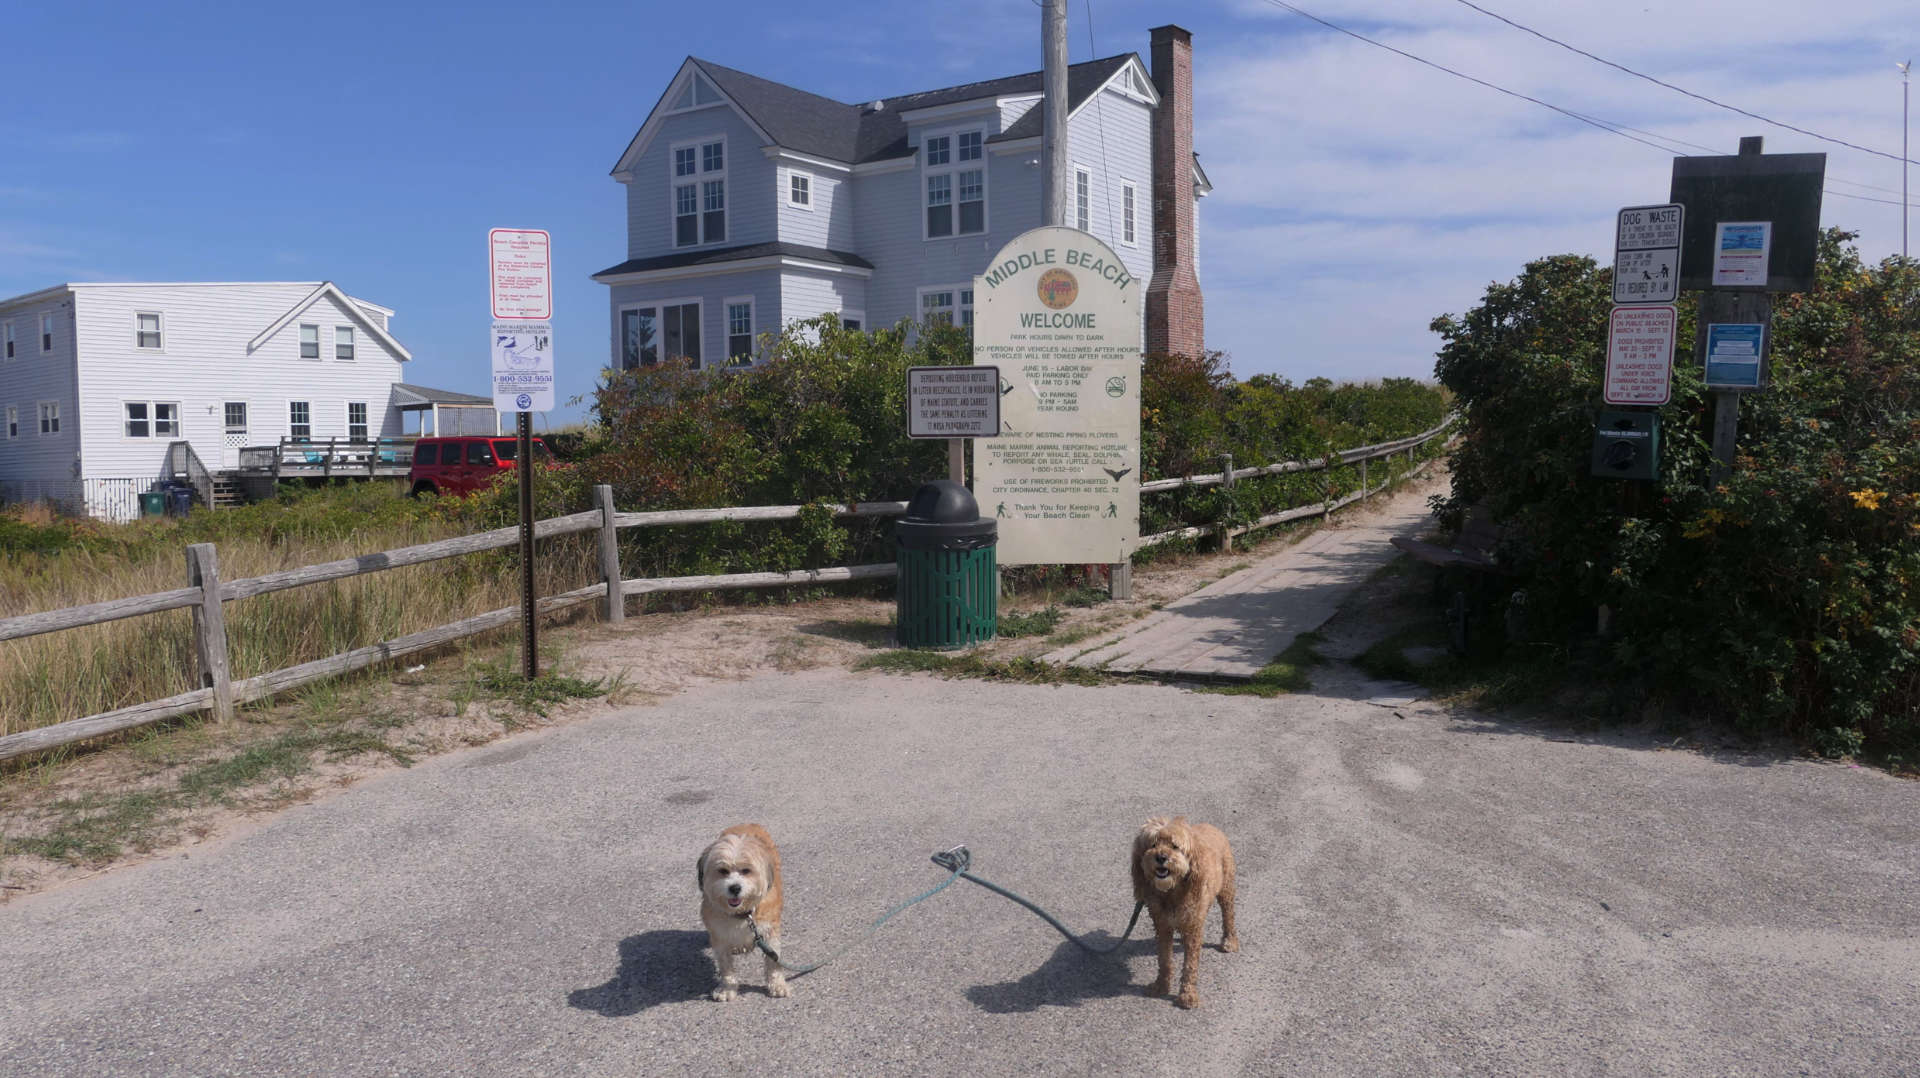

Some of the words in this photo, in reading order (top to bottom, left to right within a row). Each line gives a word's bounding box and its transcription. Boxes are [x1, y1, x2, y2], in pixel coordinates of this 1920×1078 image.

[1623, 213, 1641, 225] DOG
[1648, 210, 1677, 224] WASTE
[985, 248, 1056, 289] MIDDLE
[1065, 249, 1131, 290] BEACH
[1020, 313, 1096, 328] WELCOME
[1069, 504, 1100, 512] Keeping
